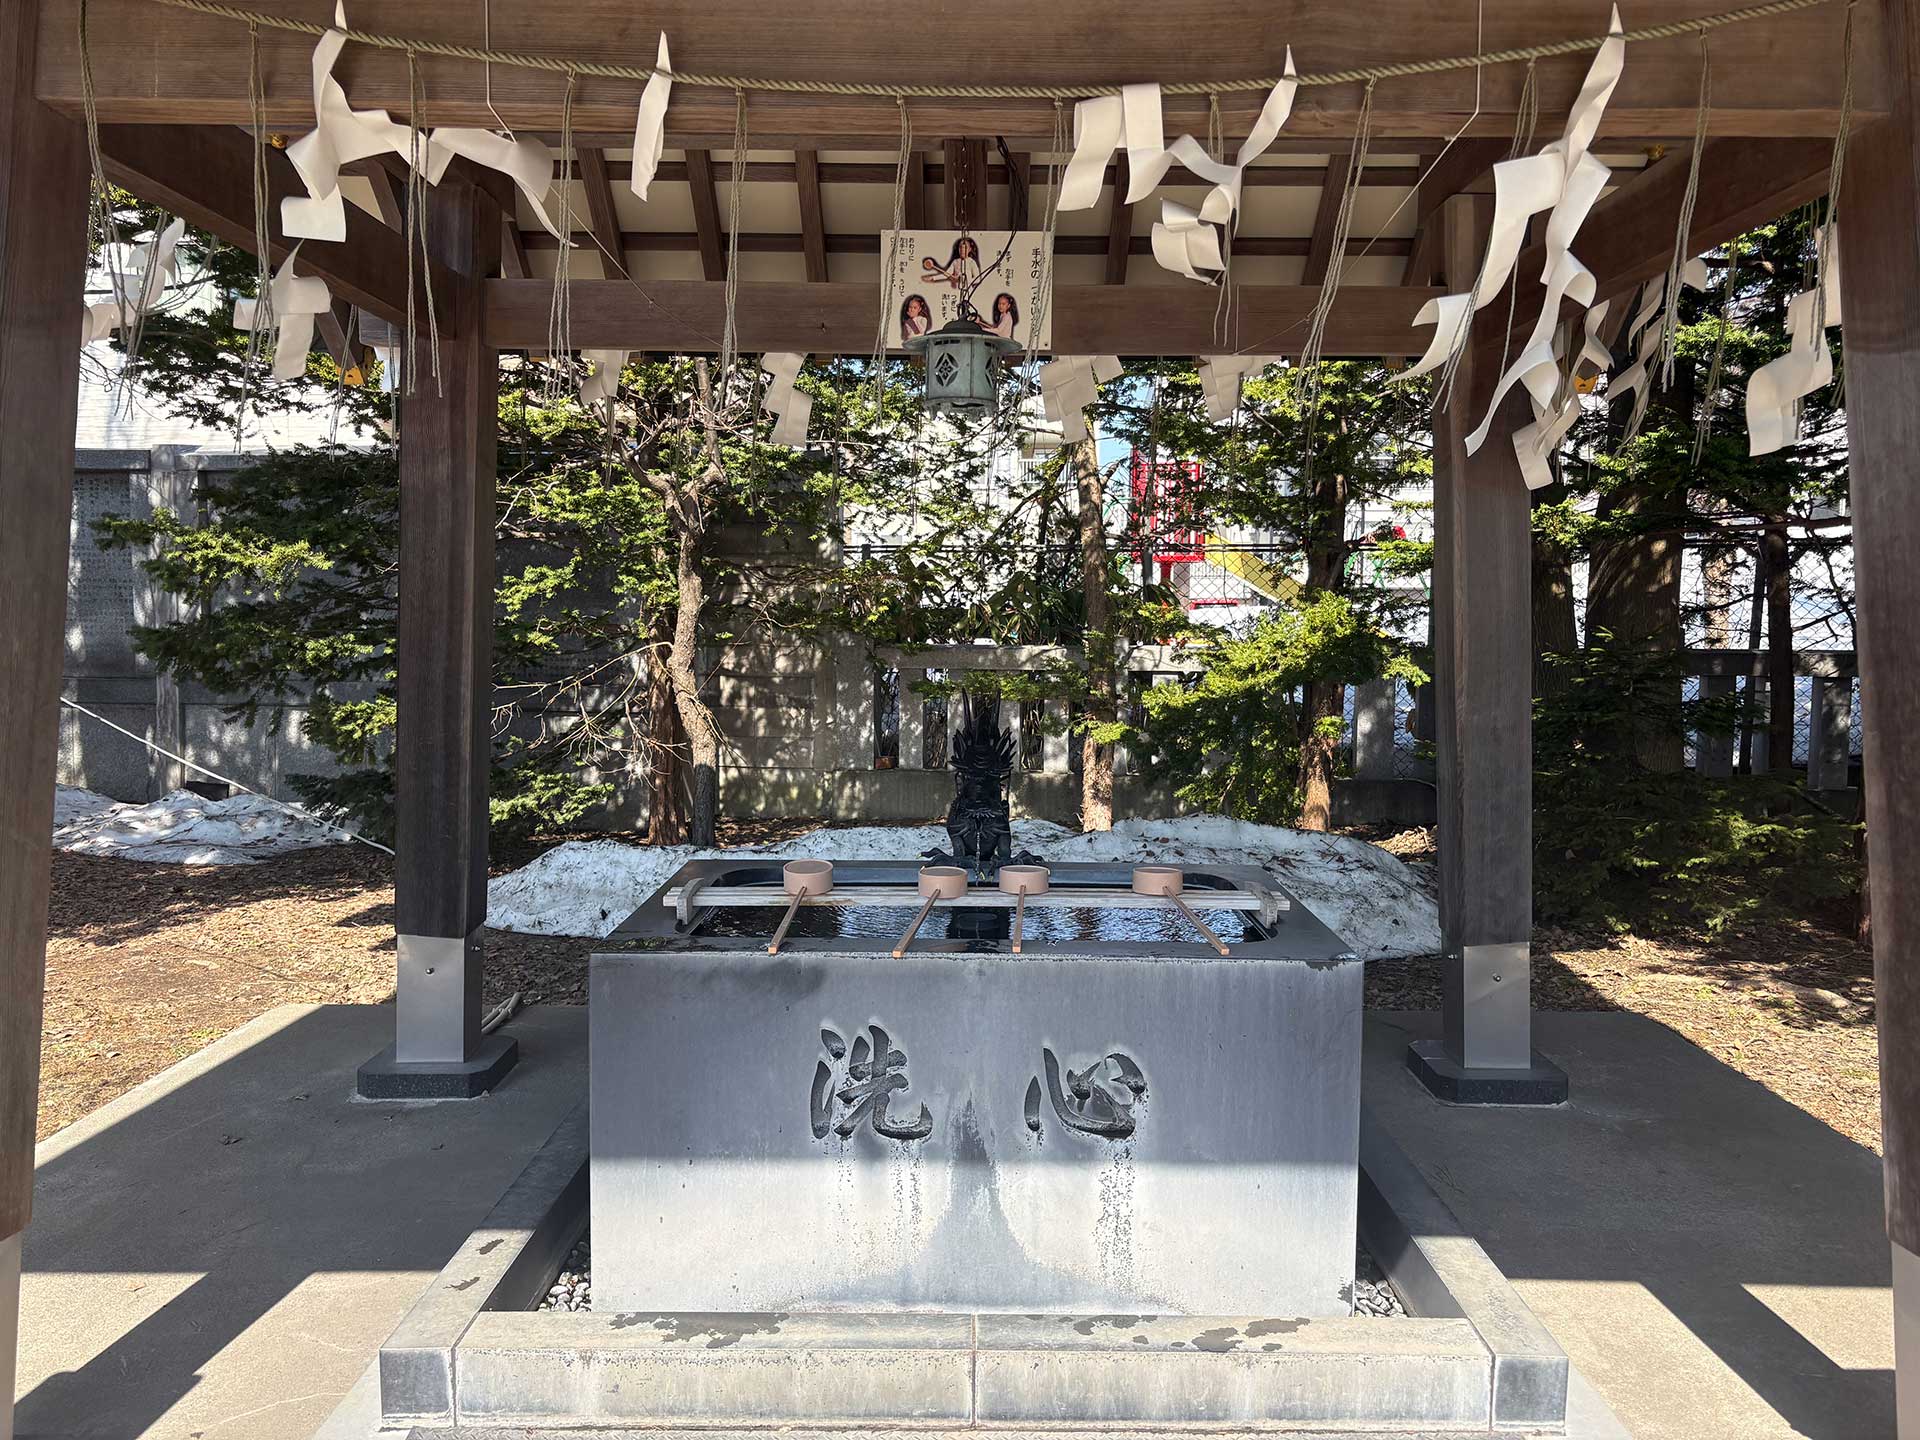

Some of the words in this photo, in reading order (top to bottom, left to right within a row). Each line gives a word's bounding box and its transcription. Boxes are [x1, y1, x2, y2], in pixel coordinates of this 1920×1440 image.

[1031, 248, 1041, 280] 手水の
[810, 1024, 1146, 1140] 洗心
